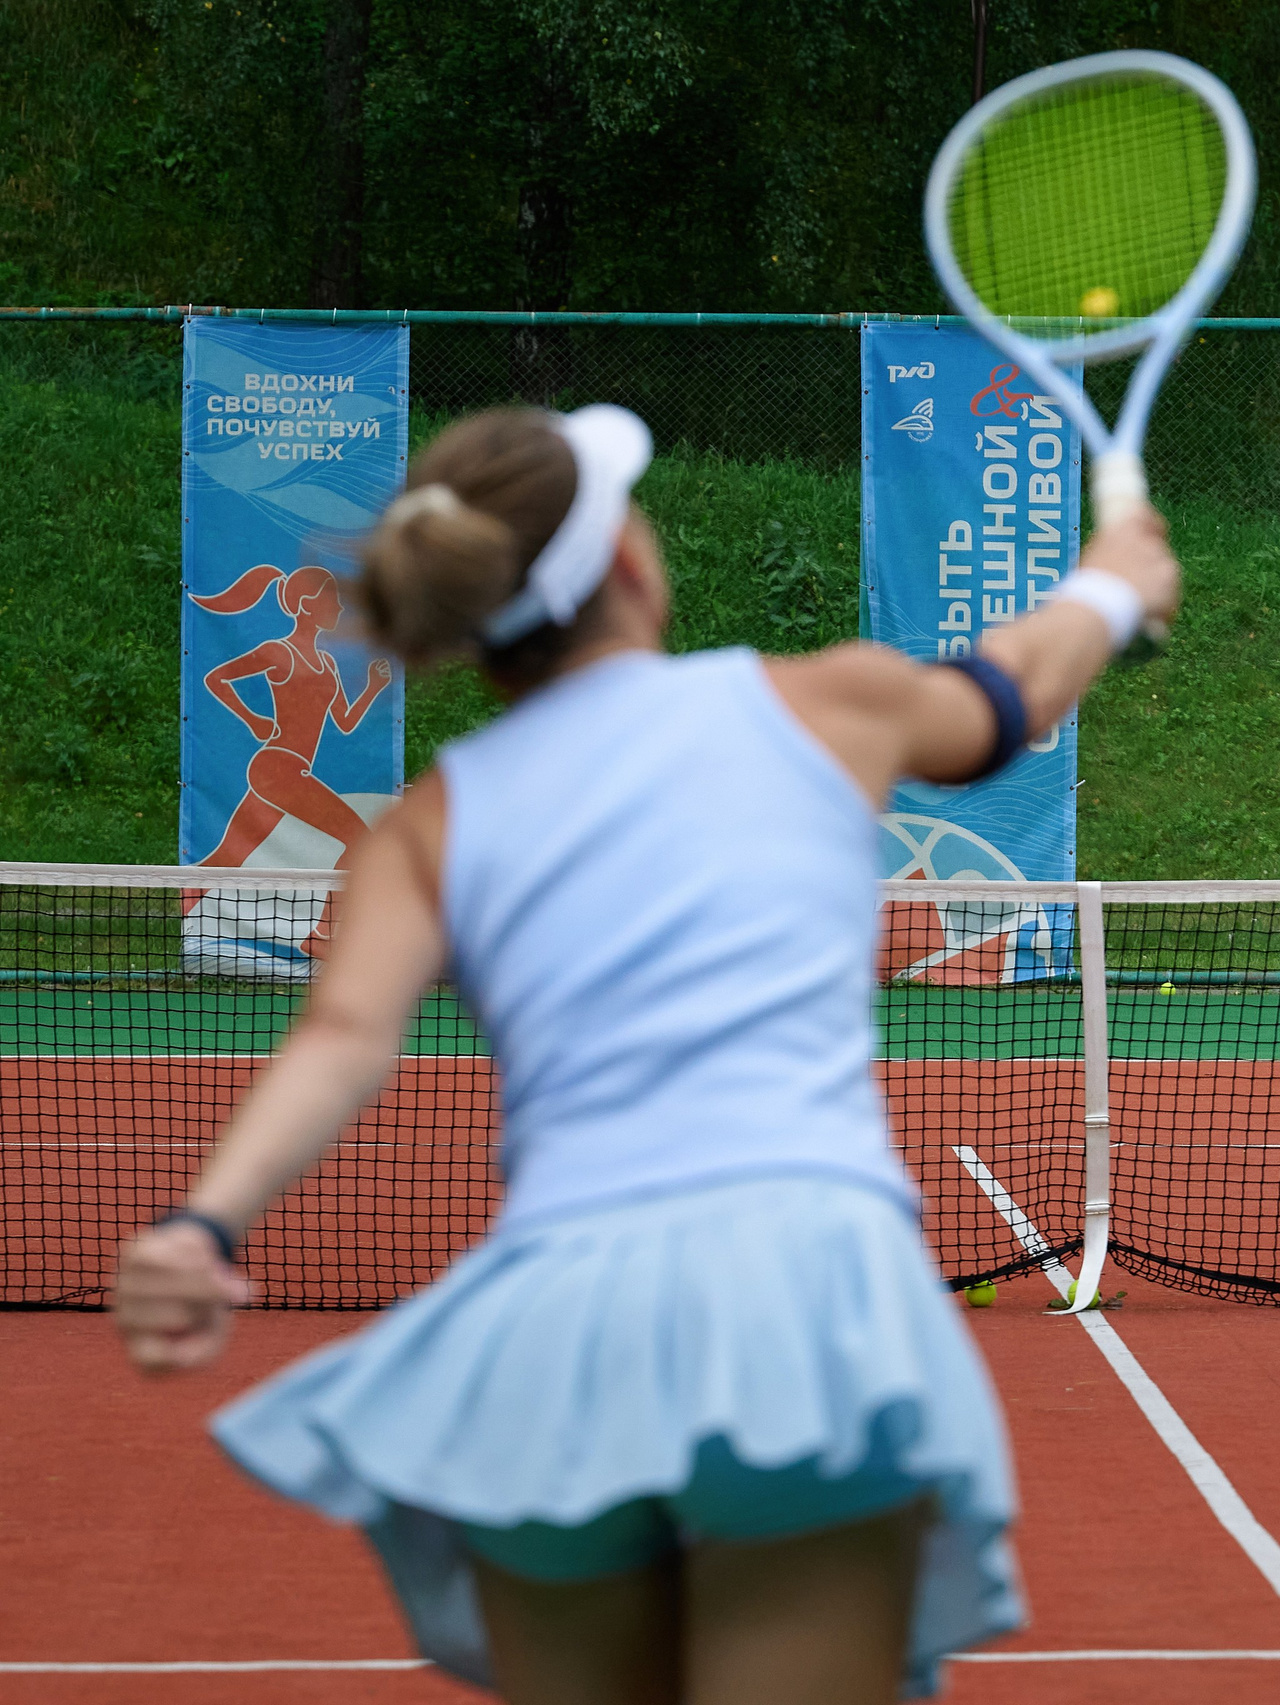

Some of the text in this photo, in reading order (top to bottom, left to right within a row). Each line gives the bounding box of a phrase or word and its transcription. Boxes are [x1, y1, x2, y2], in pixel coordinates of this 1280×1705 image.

[244, 373, 355, 394] ВДОХНИ
[207, 395, 336, 418] СВОБОДУ,
[207, 417, 380, 439] ПОЧУВСТВУЙ
[257, 442, 344, 461] УСПЕХ
[975, 425, 1018, 647] ЕШНОЙ
